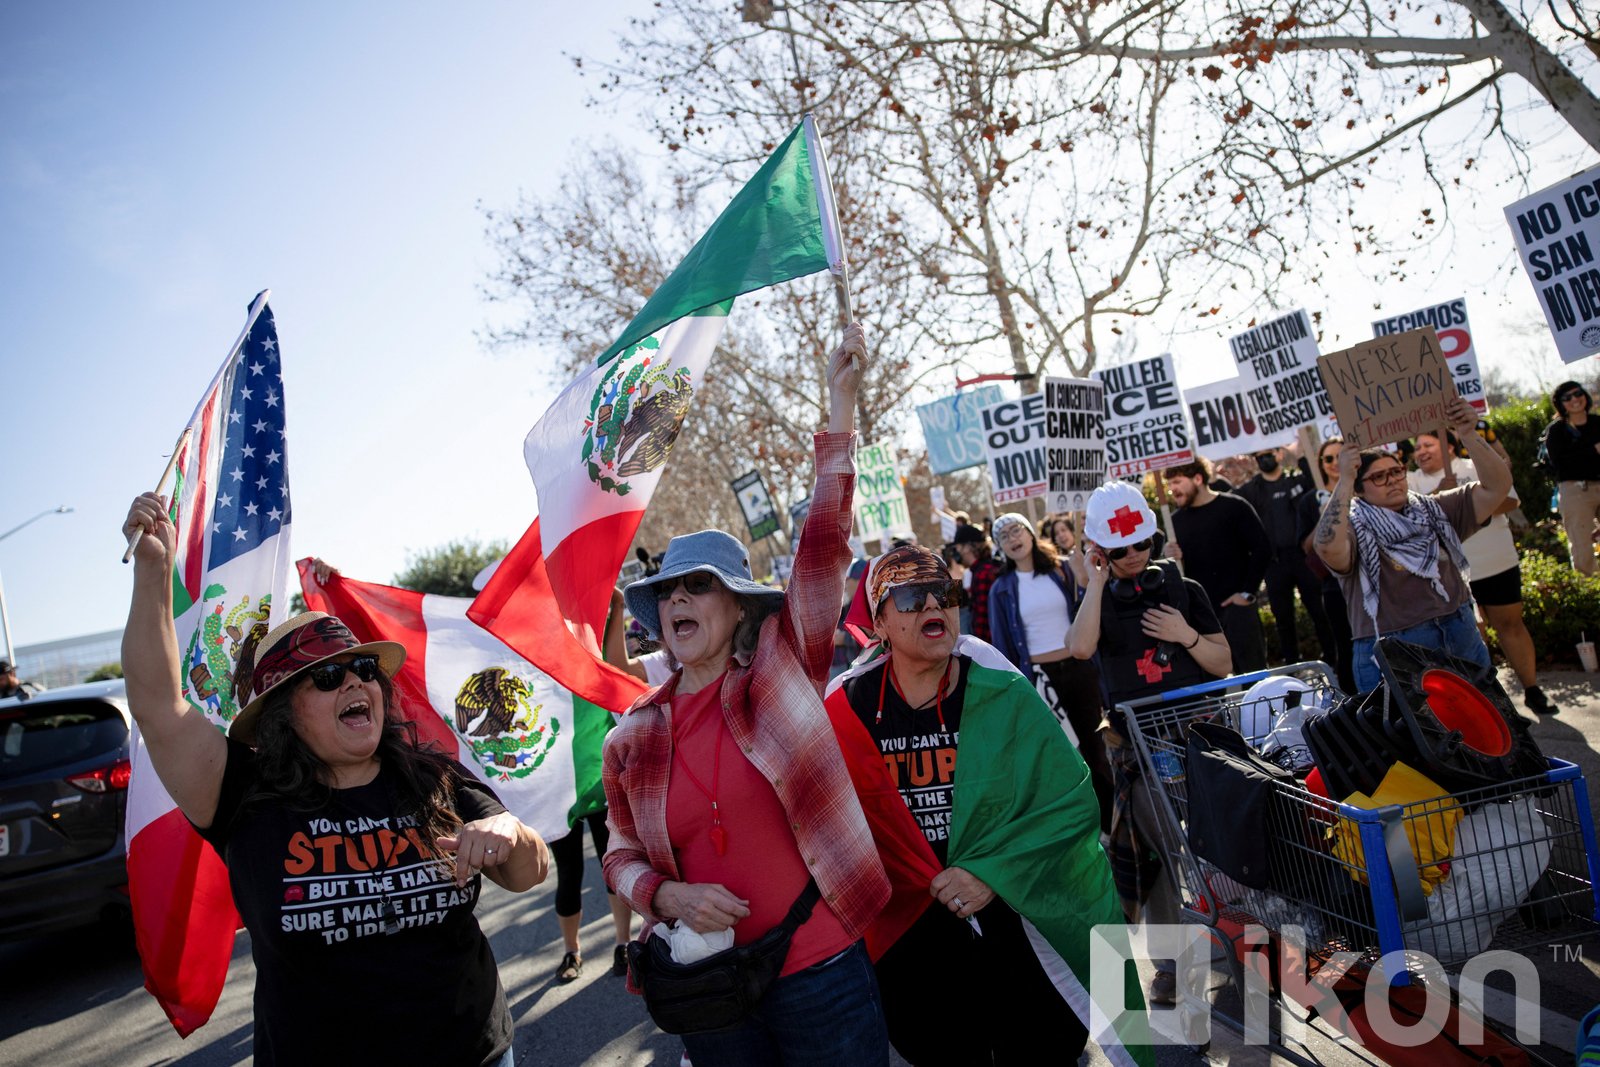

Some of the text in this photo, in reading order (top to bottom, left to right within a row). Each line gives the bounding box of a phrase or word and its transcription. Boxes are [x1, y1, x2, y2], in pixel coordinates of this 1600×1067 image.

[1516, 202, 1562, 245] NO
[1528, 230, 1595, 282] SAN
[1543, 282, 1576, 332] NO
[1231, 311, 1308, 363] LEGALIZATION
[1099, 356, 1167, 396] KILLER
[1251, 345, 1301, 381] FOR ALL
[1326, 341, 1409, 396] WE'RE
[1419, 335, 1438, 368] A
[1046, 382, 1055, 409] NO
[1104, 382, 1179, 420] ICE
[1247, 385, 1276, 414] THE
[1354, 368, 1443, 421] NATION
[920, 402, 949, 434] NO
[982, 395, 1046, 431] ICE
[1047, 411, 1104, 440] CAMPS
[1105, 413, 1183, 437] OFF OUR
[1257, 398, 1316, 436] CROSSED
[988, 420, 1046, 449] OUT
[1106, 424, 1188, 463] STREETS
[857, 442, 893, 471] EOPLE
[994, 447, 1046, 489] NOW
[1048, 448, 1104, 471] SOLIDARITY
[858, 467, 901, 497] OVER
[1049, 472, 1065, 492] WITH
[880, 737, 907, 752] YOU
[911, 732, 951, 749] CAN'T
[914, 791, 947, 807] THE
[309, 818, 341, 835] YOU
[283, 827, 432, 875] STUPI
[309, 880, 350, 900] BUT
[354, 873, 395, 895] THE
[281, 908, 336, 932] SURE
[411, 894, 429, 913] IT
[436, 885, 476, 909] EASY
[322, 927, 349, 945] TO
